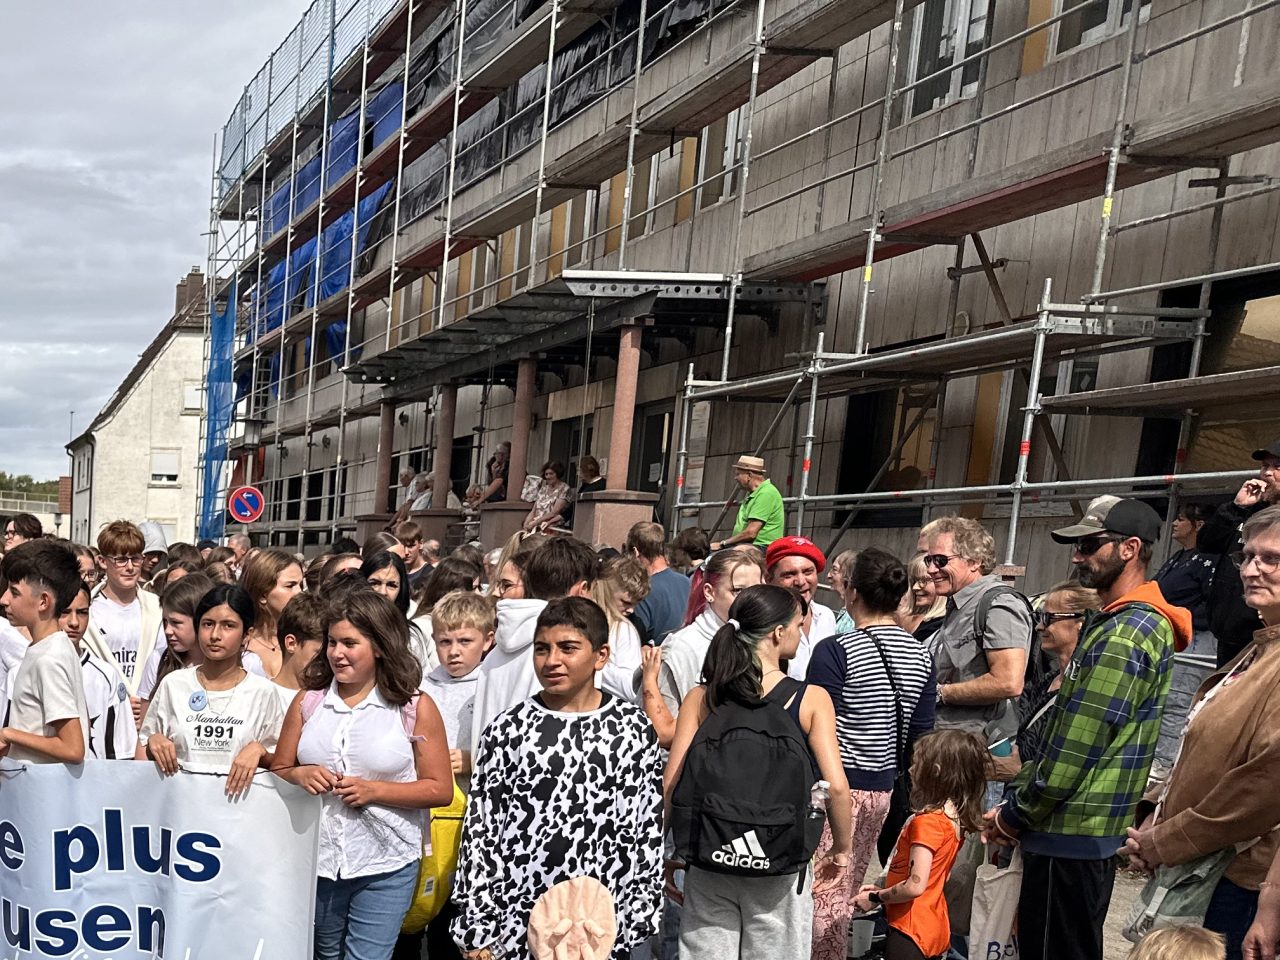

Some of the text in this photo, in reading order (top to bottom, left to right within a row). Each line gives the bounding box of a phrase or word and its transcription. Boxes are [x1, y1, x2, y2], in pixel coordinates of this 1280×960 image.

[112, 647, 137, 663] mira
[186, 713, 244, 725] Manhattan
[194, 725, 234, 739] 1991
[194, 738, 230, 747] New York
[52, 808, 223, 892] plus
[711, 850, 770, 870] adidas
